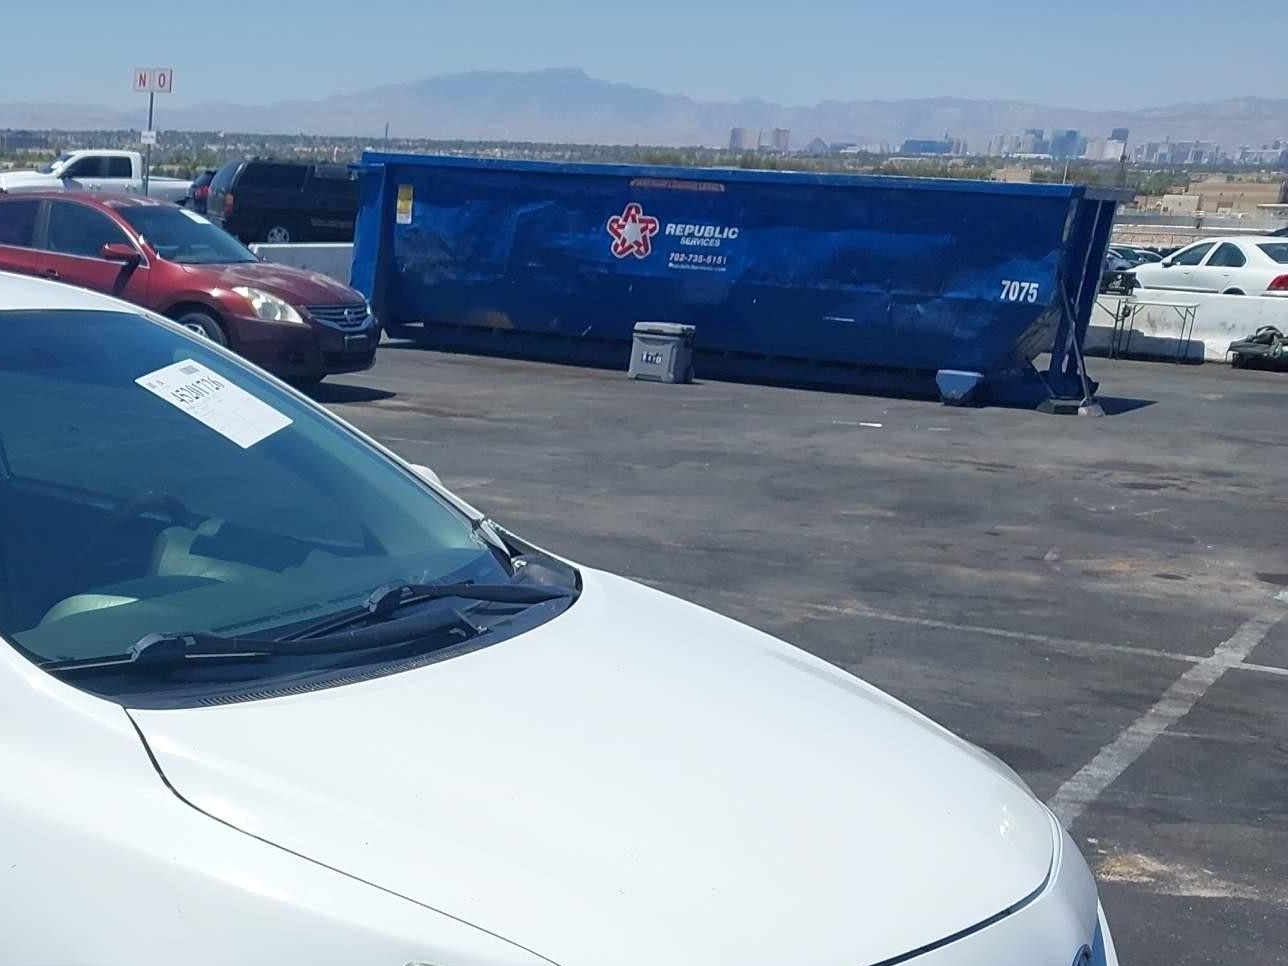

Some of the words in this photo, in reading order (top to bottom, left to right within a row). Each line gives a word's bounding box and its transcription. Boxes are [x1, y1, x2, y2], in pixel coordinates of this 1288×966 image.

[665, 223, 740, 239] REPUBLIC
[680, 237, 721, 247] SERVICES
[668, 252, 727, 265] 702-735-5151
[1000, 279, 1039, 303] 7075
[170, 375, 225, 404] 45201726
